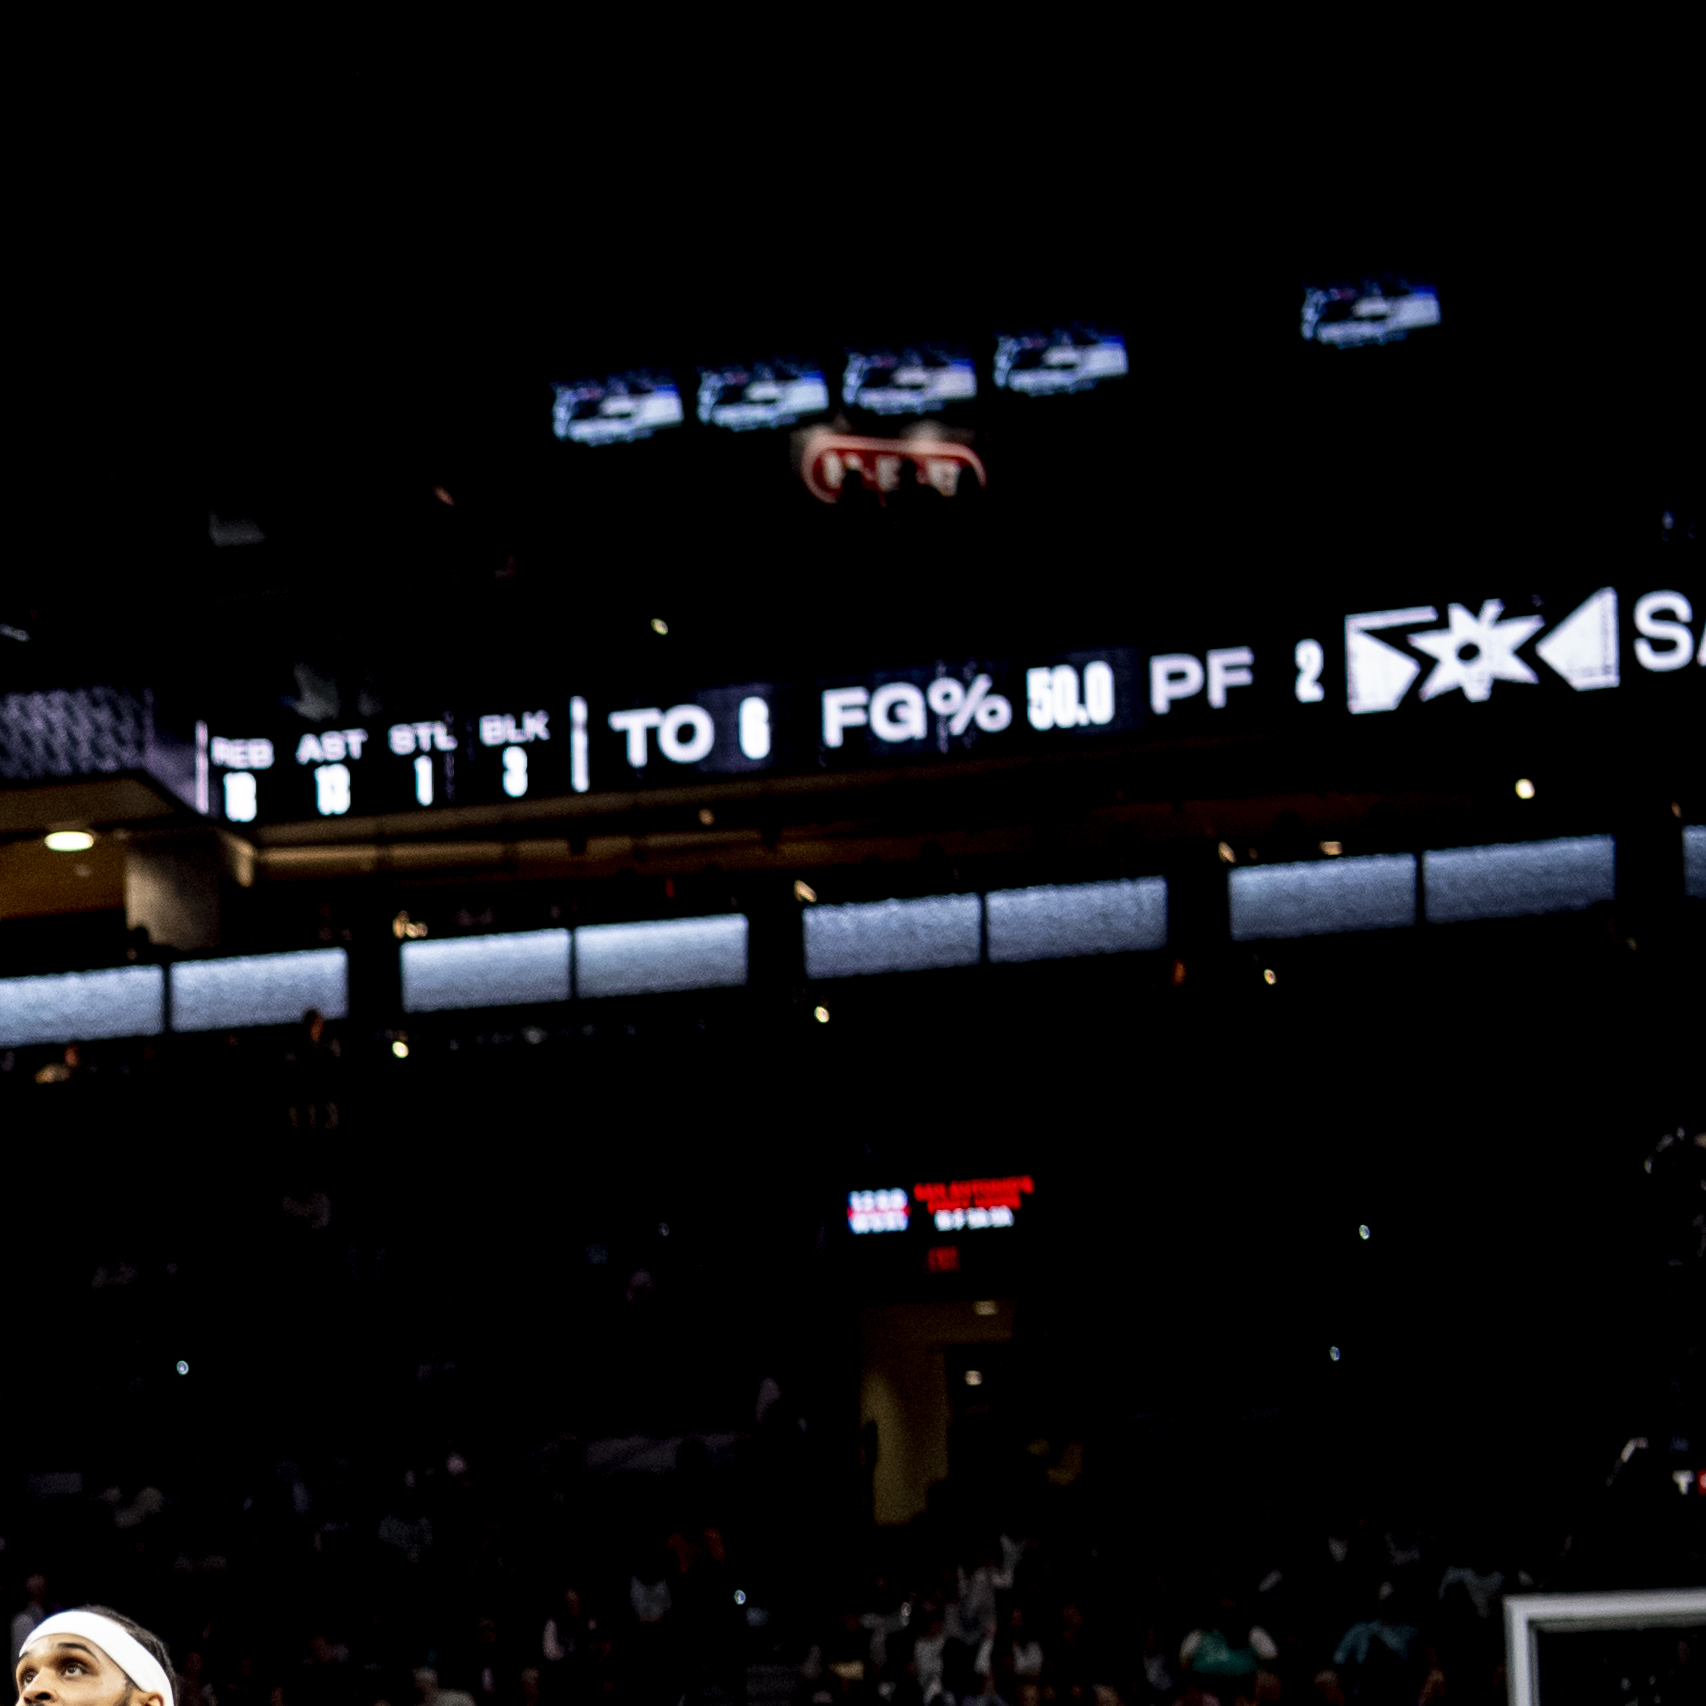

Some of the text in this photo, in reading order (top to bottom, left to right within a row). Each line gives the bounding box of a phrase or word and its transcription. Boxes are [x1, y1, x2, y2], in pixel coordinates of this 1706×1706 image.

[211, 709, 551, 770] REB AST STL BLK
[608, 703, 716, 768] TO
[821, 672, 1014, 748] FG%
[1148, 646, 1255, 715] PF
[1293, 638, 1326, 703] 2
